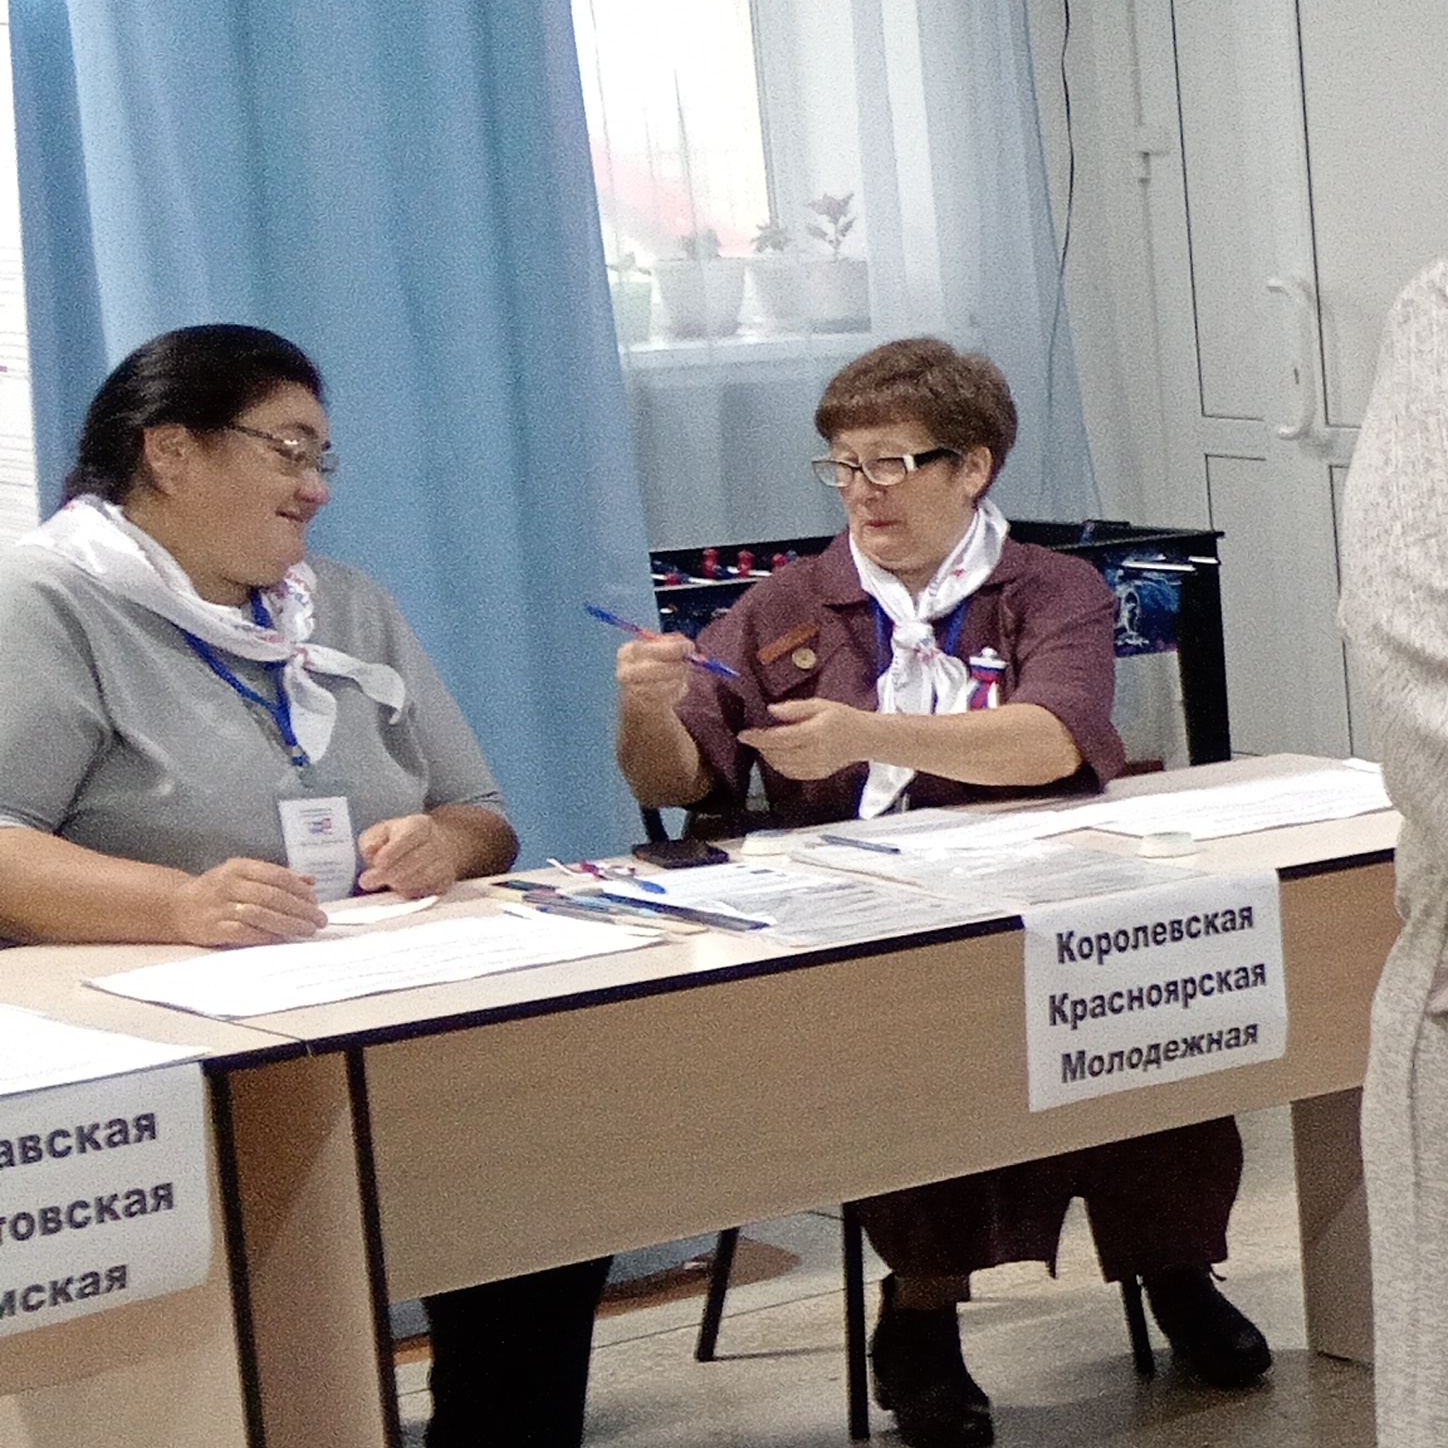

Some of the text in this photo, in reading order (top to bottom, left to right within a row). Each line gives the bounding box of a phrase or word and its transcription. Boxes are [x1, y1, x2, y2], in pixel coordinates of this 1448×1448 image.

[1057, 906, 1254, 965] Королевская
[1049, 963, 1267, 1029] Красноярская
[1061, 1023, 1258, 1083] Молодежная
